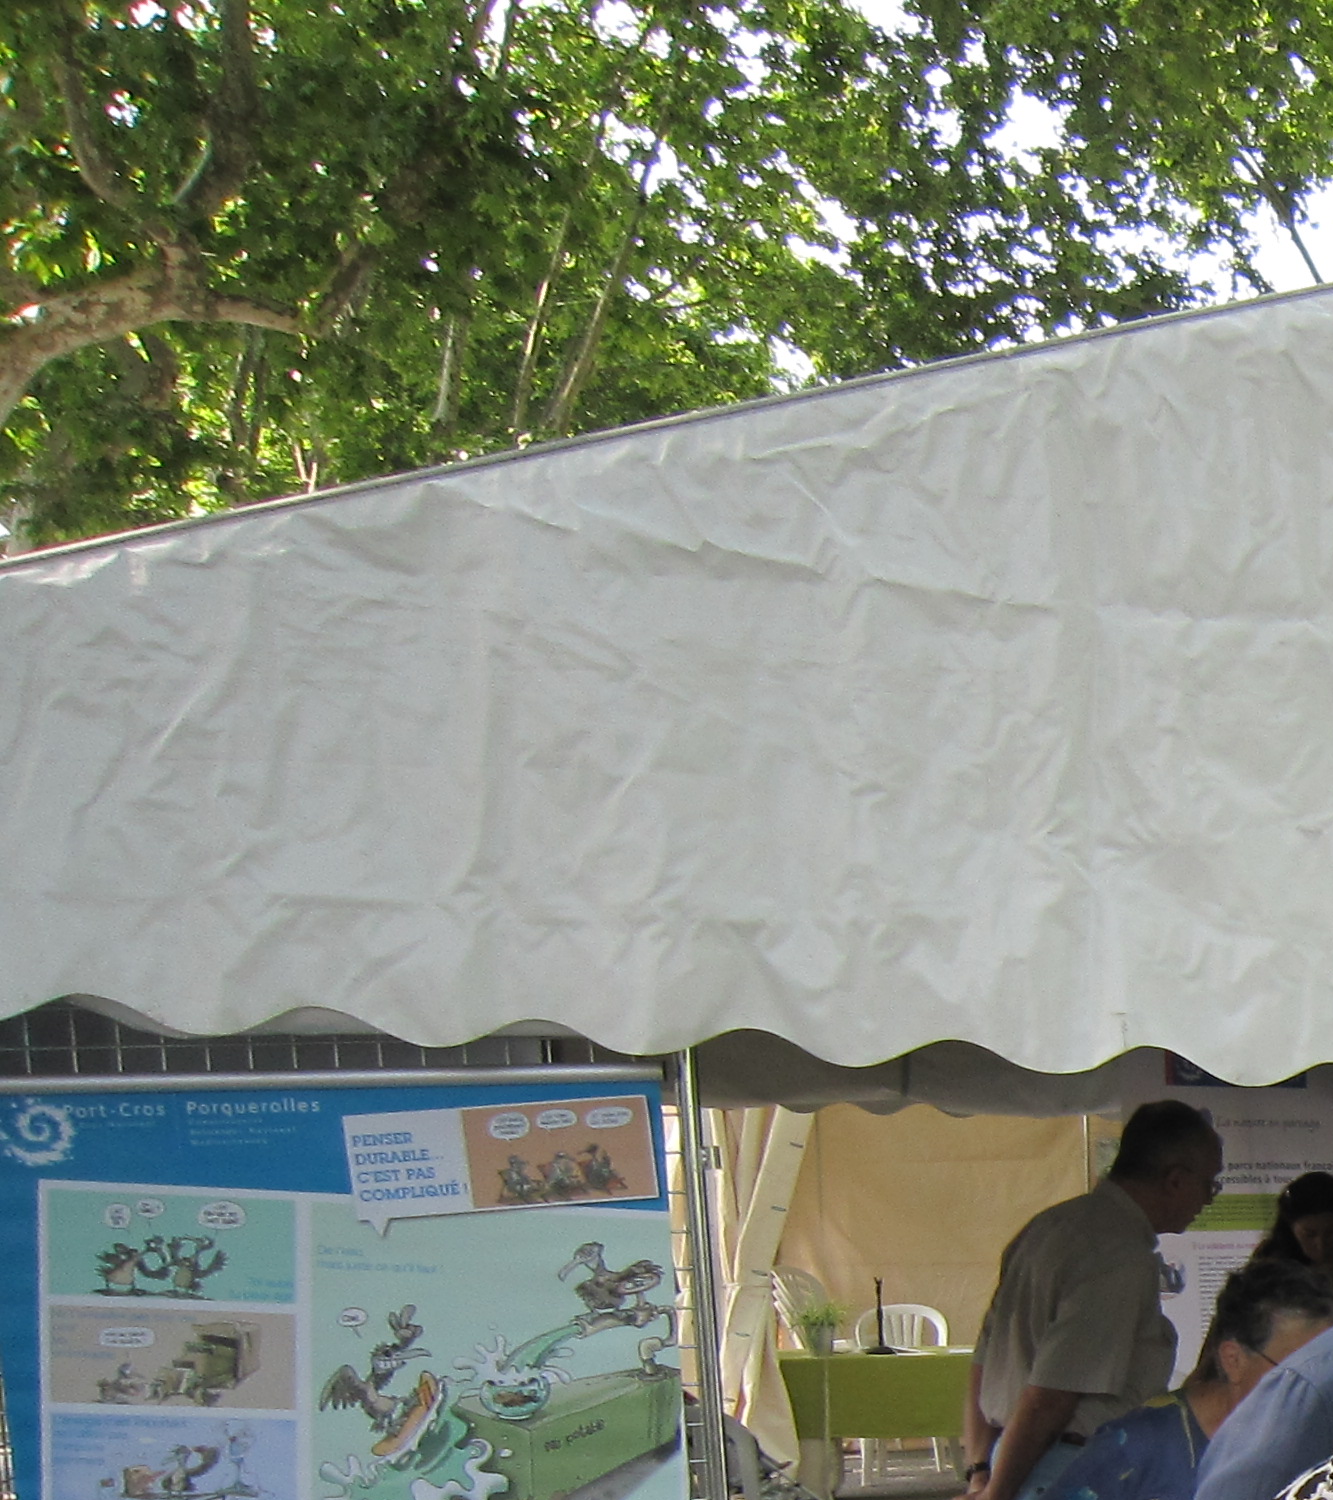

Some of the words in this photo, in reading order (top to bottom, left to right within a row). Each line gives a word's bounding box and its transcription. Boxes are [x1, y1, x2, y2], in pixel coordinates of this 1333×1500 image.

[186, 1097, 321, 1116] Porquerolles
[352, 1132, 413, 1149] PENSER
[357, 1168, 401, 1185] C'EST
[405, 1166, 436, 1181] PAS
[359, 1179, 461, 1202] COMPLIQUÉ
